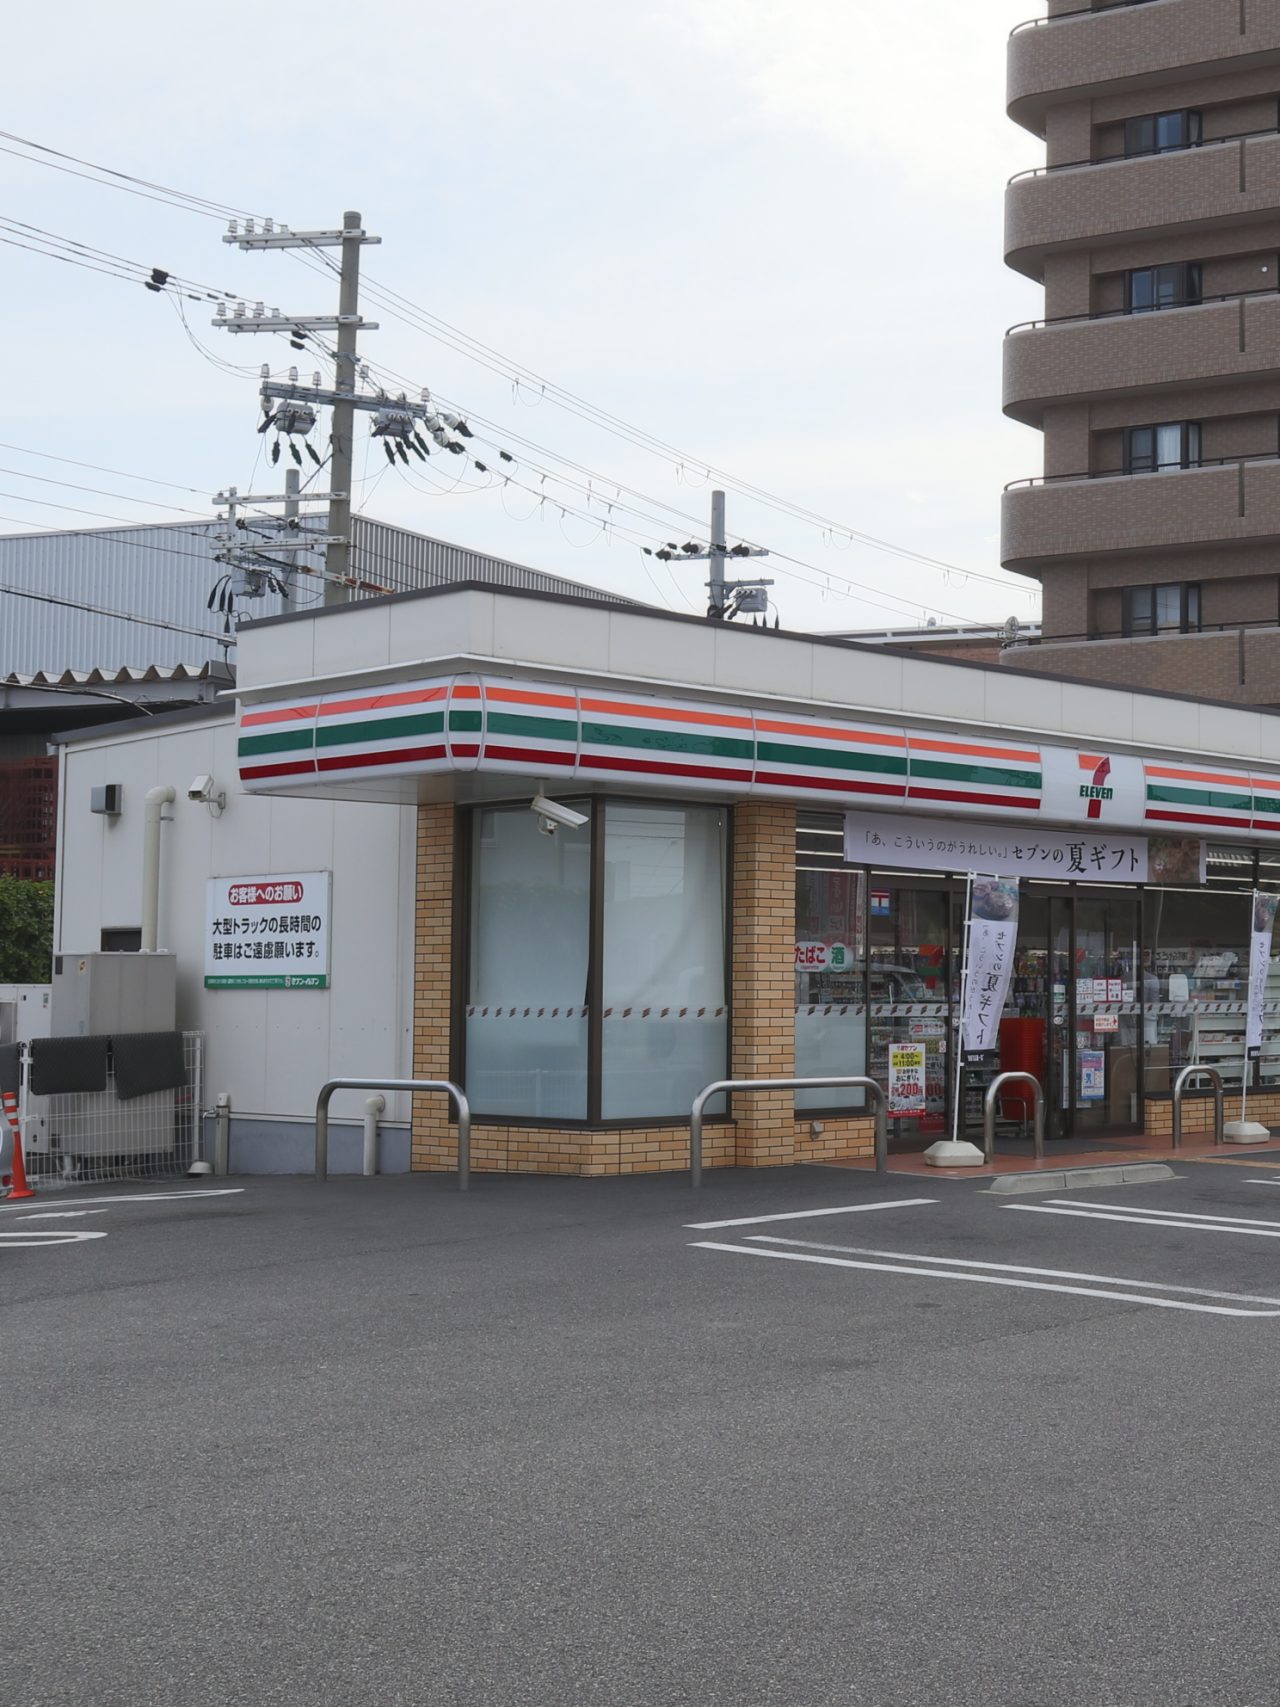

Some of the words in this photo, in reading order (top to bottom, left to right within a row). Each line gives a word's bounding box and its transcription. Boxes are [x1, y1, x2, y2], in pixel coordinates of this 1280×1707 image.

[1078, 754, 1111, 818] 7
[229, 884, 302, 904] お客様へのお願い
[212, 915, 322, 935] 大型トラックの長時間の
[213, 941, 320, 960] 駐車はご遠慮願います。
[795, 946, 826, 964] たばこ
[831, 946, 844, 964] 酒
